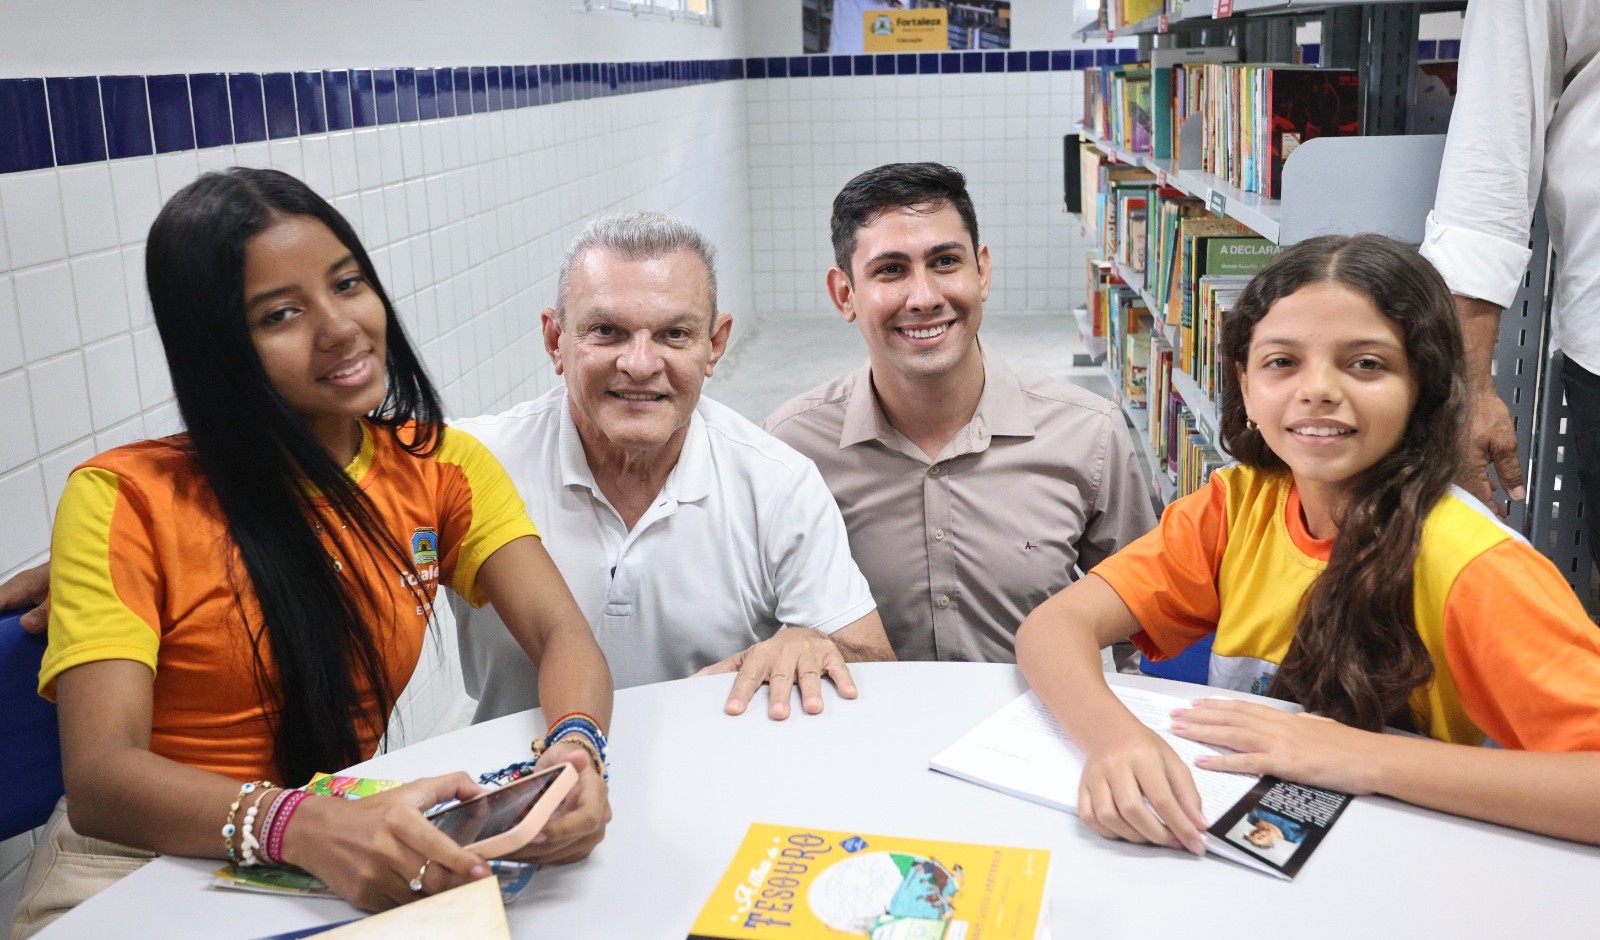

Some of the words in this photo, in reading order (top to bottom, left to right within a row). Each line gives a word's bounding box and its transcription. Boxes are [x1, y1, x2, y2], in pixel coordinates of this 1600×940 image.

[896, 17, 941, 26] Fortaleza
[1220, 245, 1228, 255] A
[1230, 245, 1284, 255] DECLARA
[743, 833, 832, 928] TESOURO
